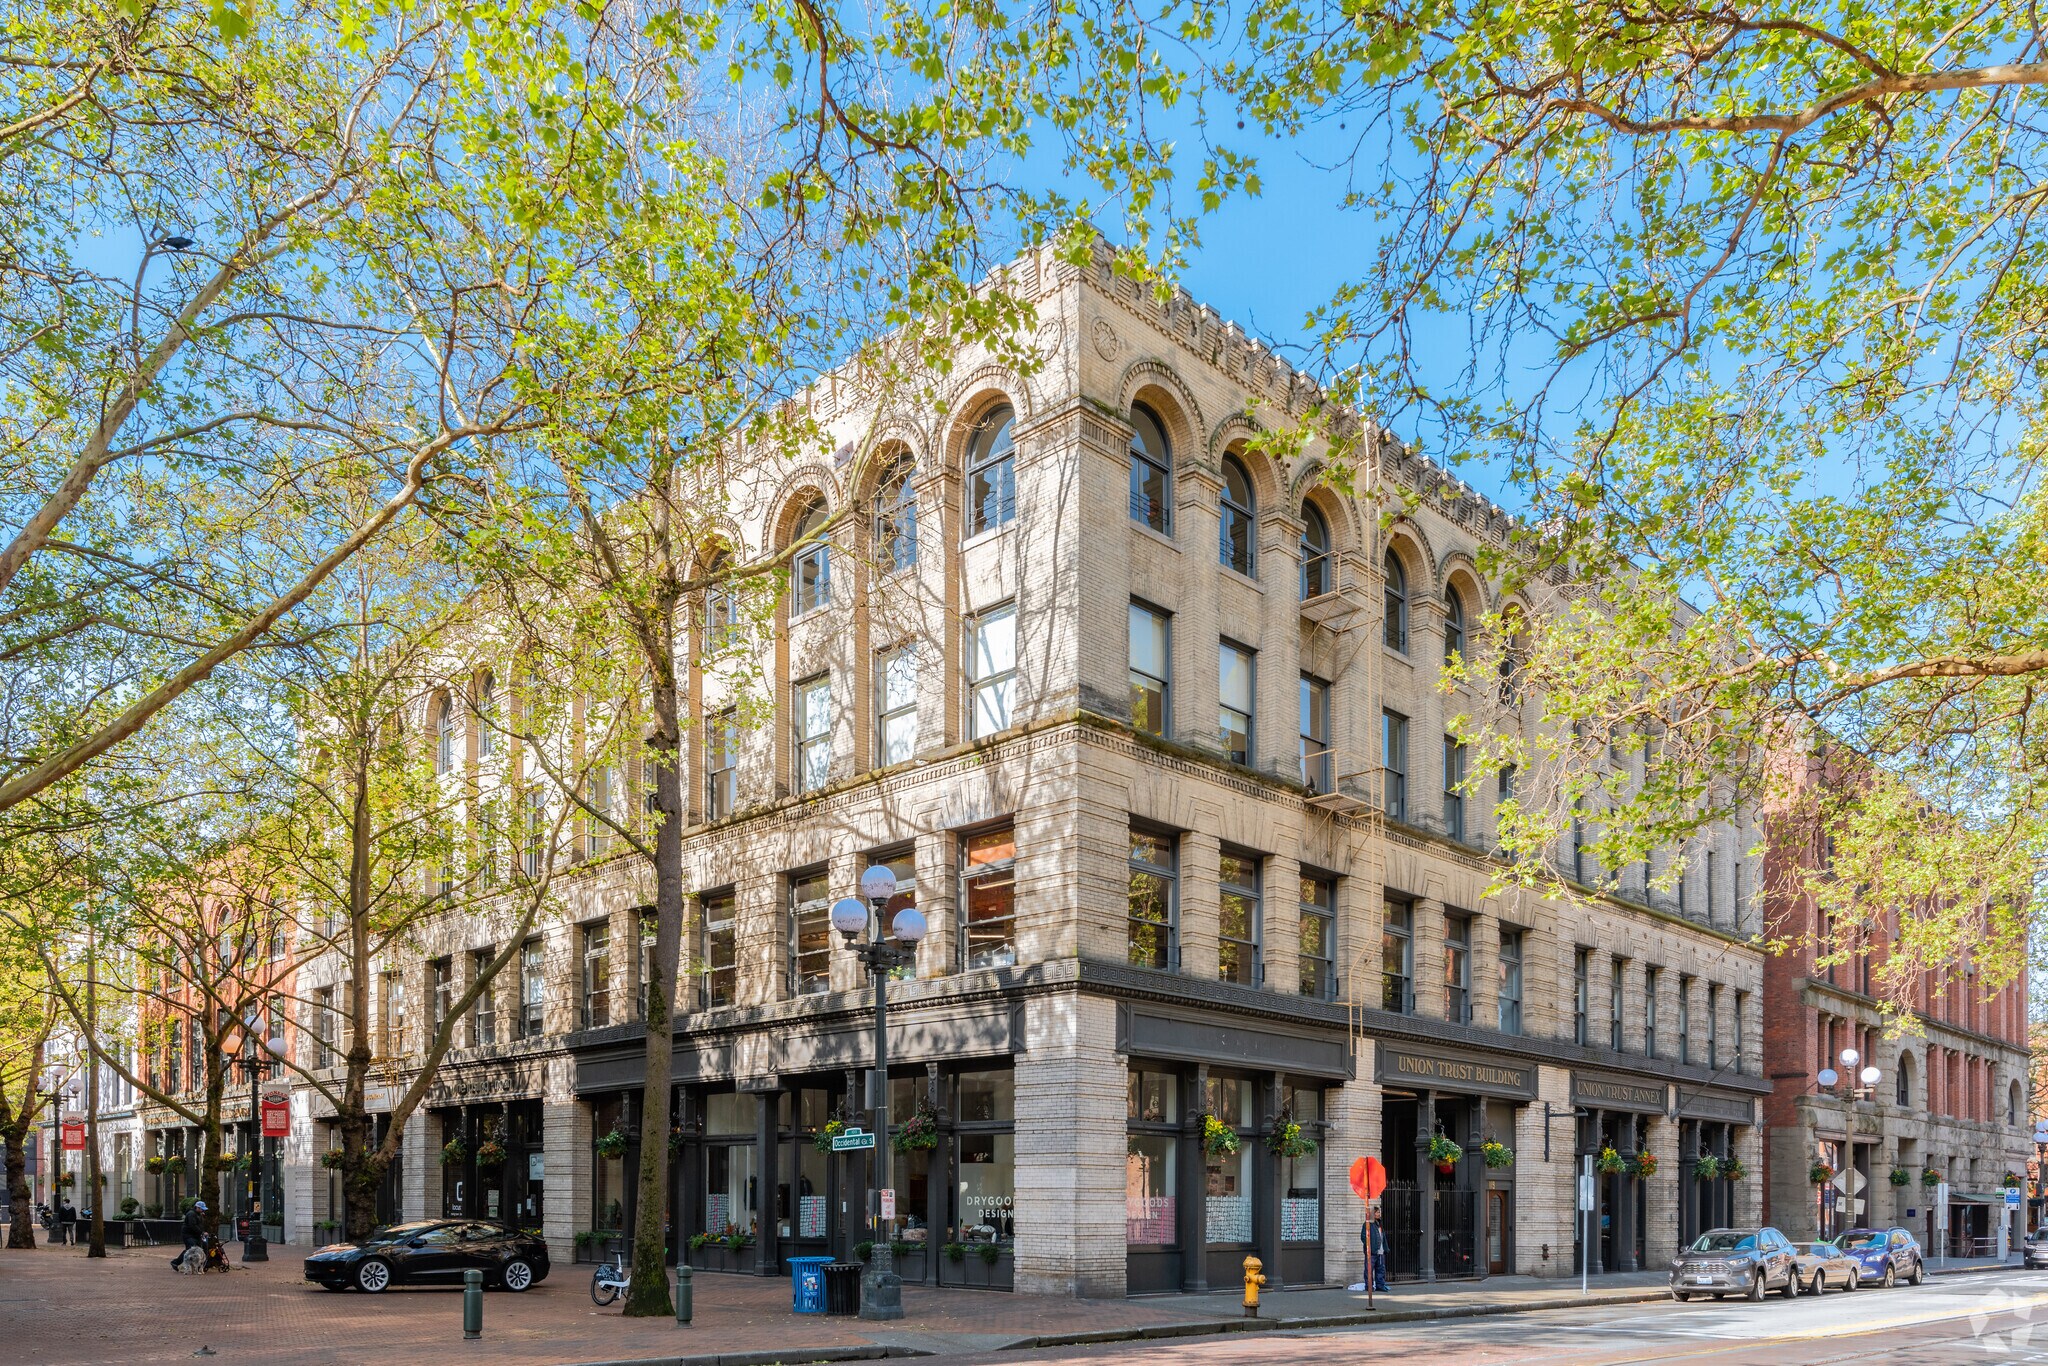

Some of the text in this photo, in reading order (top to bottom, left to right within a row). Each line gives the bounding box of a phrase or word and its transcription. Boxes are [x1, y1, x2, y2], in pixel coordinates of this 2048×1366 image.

[1398, 1056, 1521, 1087] UNION TRUST BUILDING
[1577, 1081, 1661, 1104] UNION TRUST ANNEX
[835, 1138, 860, 1147] Occidental
[966, 1196, 1015, 1206] DRYGOO
[978, 1209, 1014, 1218] DESIGN
